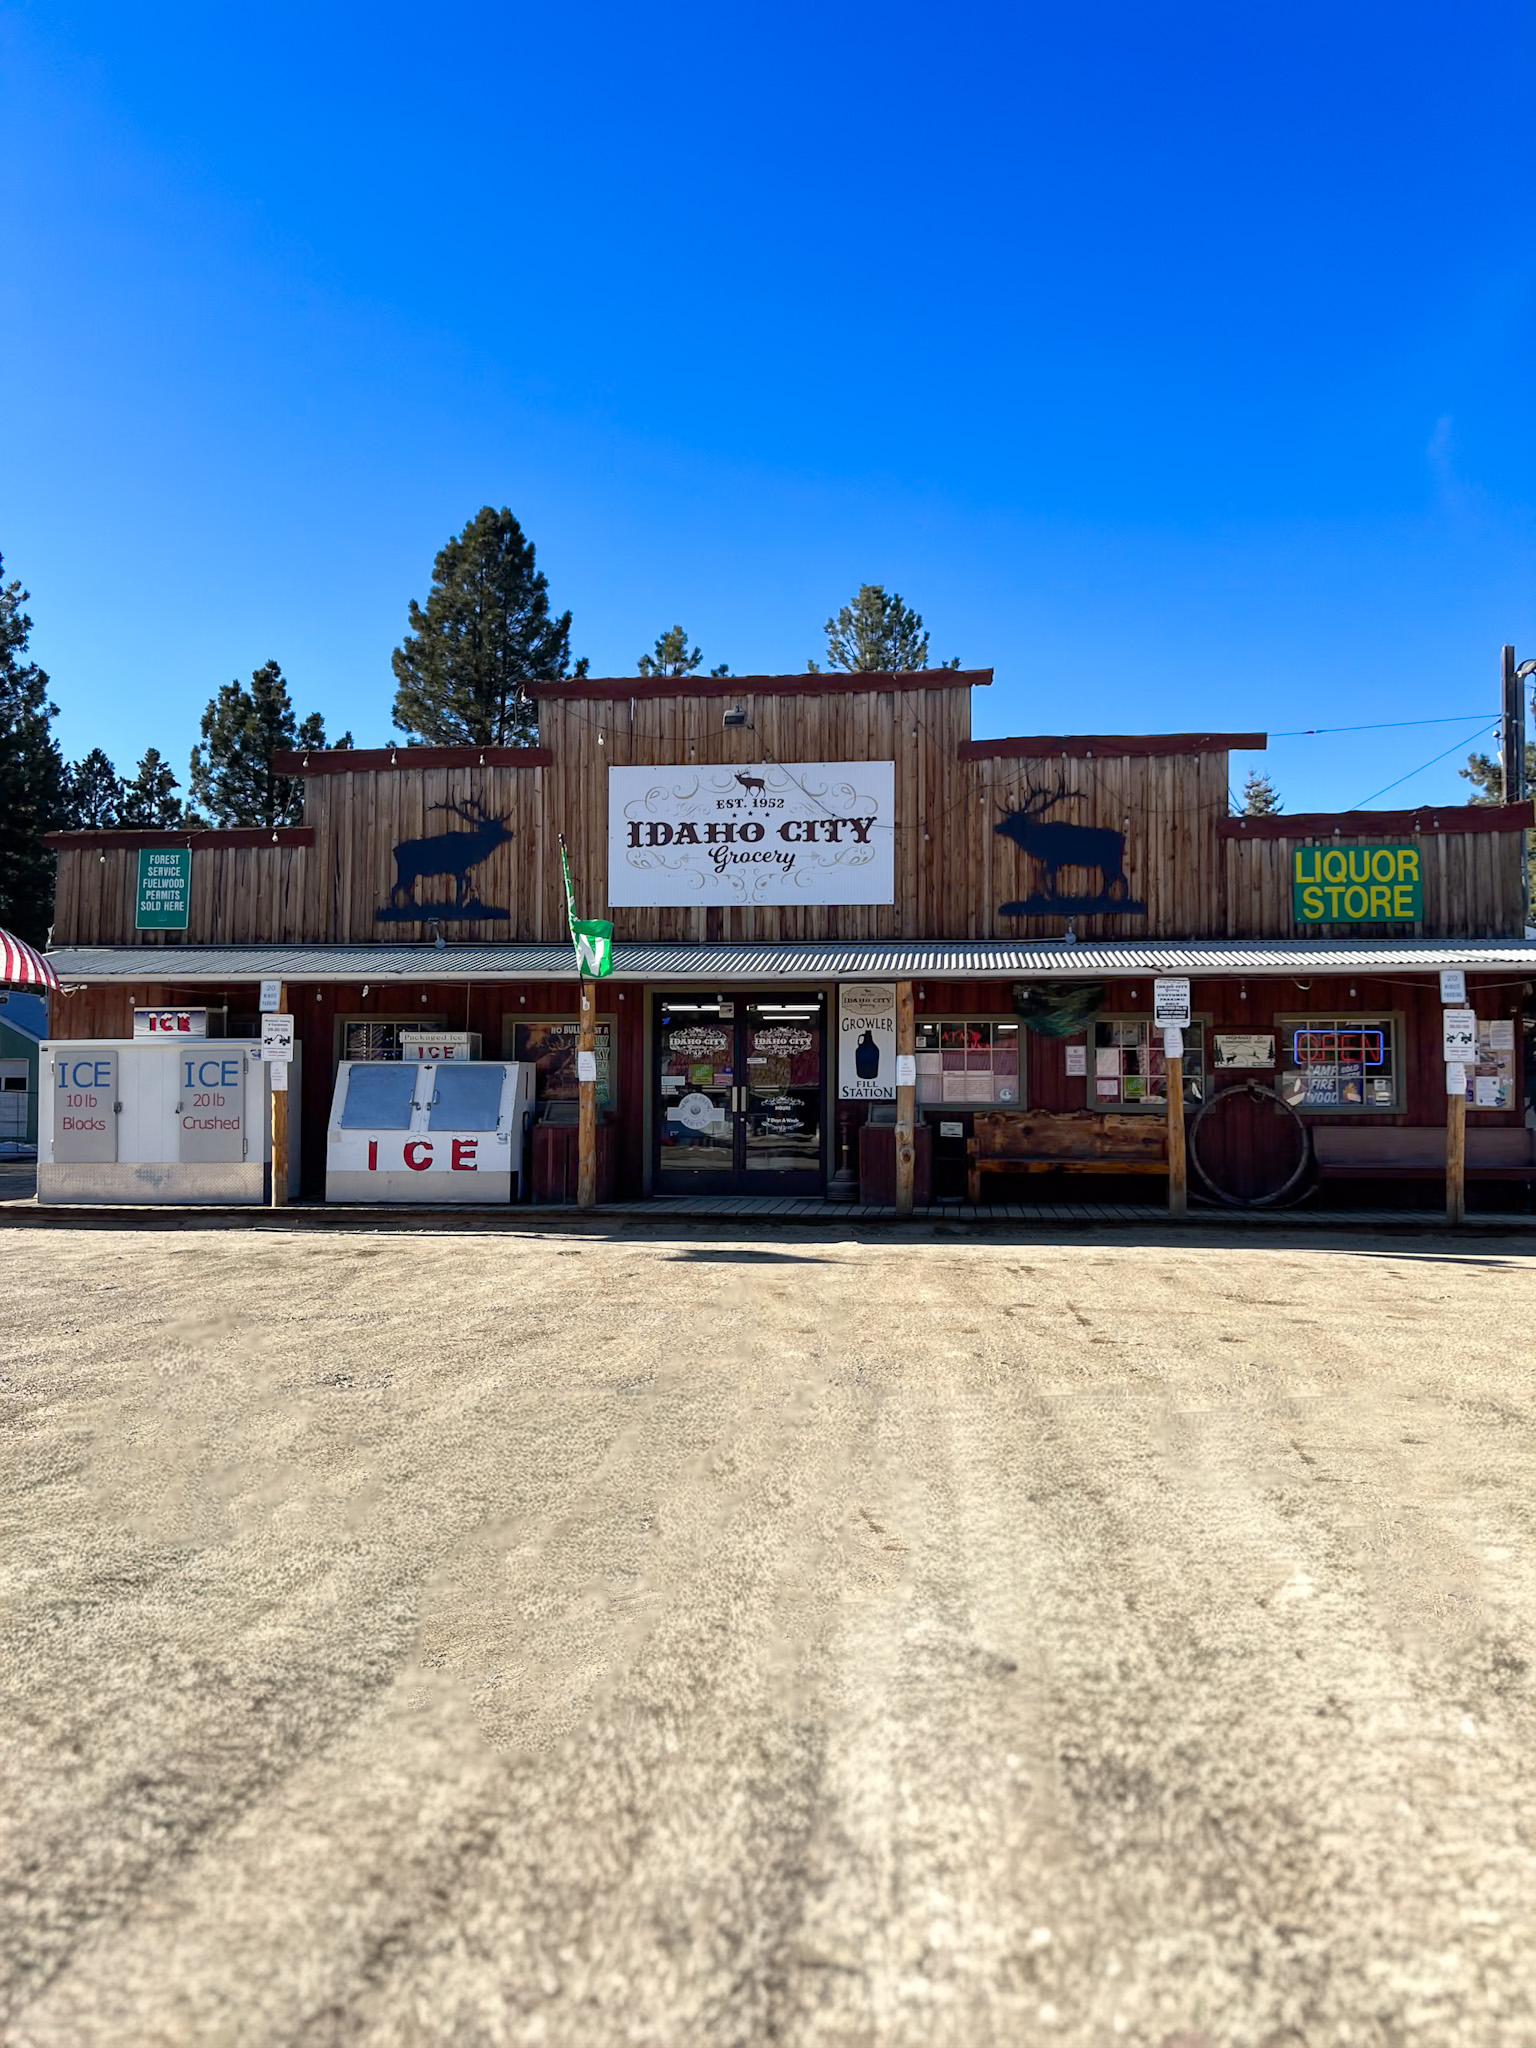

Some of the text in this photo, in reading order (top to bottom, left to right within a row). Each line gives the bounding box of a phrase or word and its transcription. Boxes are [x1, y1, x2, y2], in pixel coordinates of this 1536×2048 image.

[715, 798, 785, 809] EST. 1952
[626, 816, 877, 848] IDAHO CITY
[149, 854, 181, 865] FOREST
[709, 845, 797, 873] Grocery
[147, 866, 181, 877] SERVICE
[1295, 849, 1419, 884] LIQUOR
[142, 878, 185, 889] FUELWOOD
[145, 890, 181, 900] PERMITS
[140, 901, 185, 911] SOLD HERE
[1302, 885, 1415, 919] STORE
[1446, 974, 1458, 982] 20
[266, 984, 276, 992] 20
[148, 1012, 191, 1032] ICE
[841, 1017, 894, 1033] GROWLER
[404, 1034, 447, 1042] Packaged
[703, 1037, 727, 1045] CITY
[788, 1037, 812, 1045] CITY
[418, 1046, 454, 1059] ICE
[1297, 1033, 1380, 1063] OPEN
[58, 1061, 111, 1088] ICE
[184, 1060, 238, 1087] ICE
[856, 1080, 878, 1088] FILL
[1309, 1078, 1336, 1090] FIRE
[842, 1085, 893, 1098] STATION
[66, 1094, 97, 1108] 10 lb
[193, 1093, 226, 1107] 20 lb
[62, 1116, 106, 1131] Blocks
[182, 1116, 241, 1130] Crushed
[367, 1134, 479, 1171] ICE
